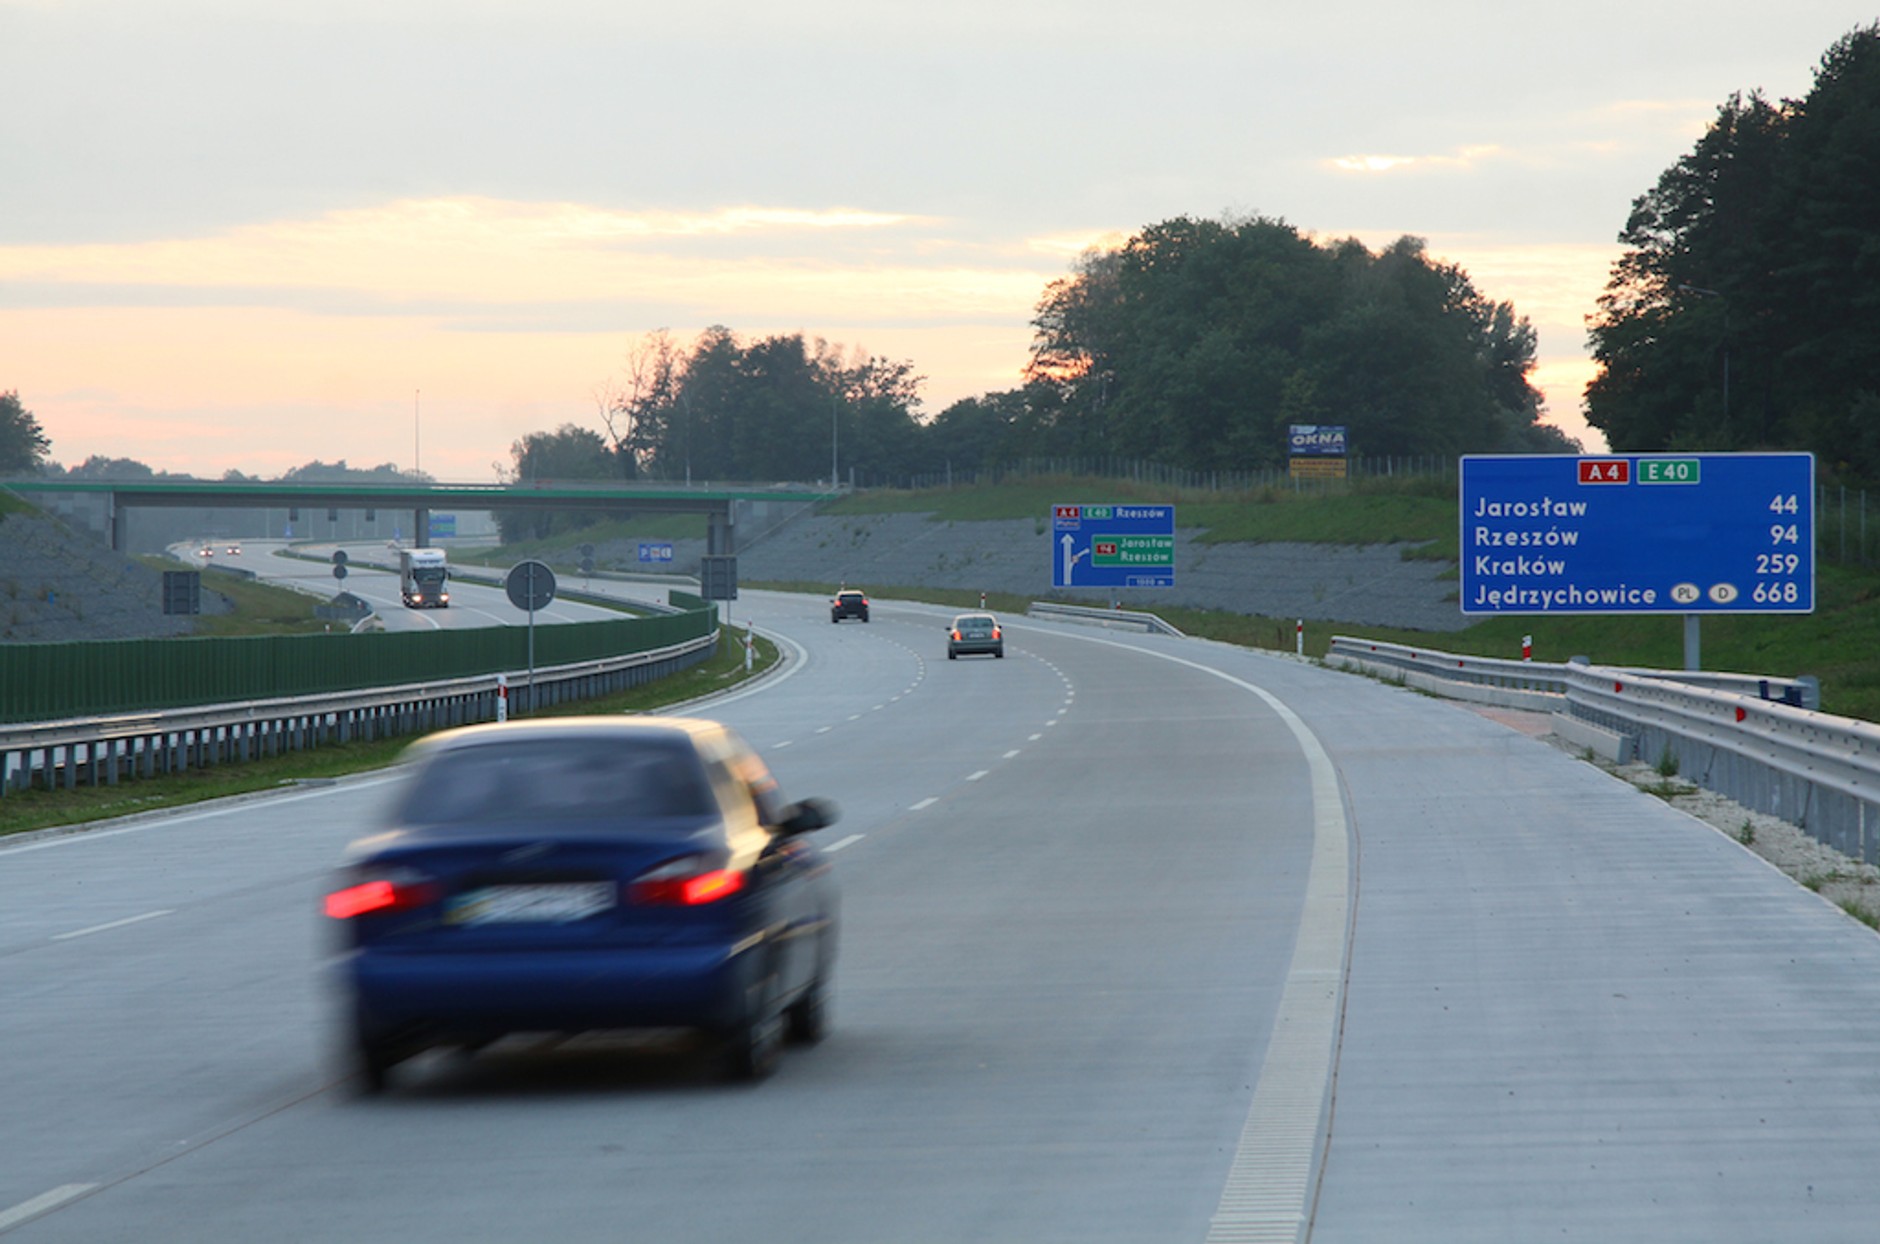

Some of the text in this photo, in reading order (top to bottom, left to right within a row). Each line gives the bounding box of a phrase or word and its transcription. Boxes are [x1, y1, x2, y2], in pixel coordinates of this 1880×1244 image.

[1292, 433, 1345, 446] OKNA
[1664, 464, 1688, 480] 40
[1116, 506, 1165, 518] Rzeszów
[1475, 495, 1798, 517] Jarosław 44
[1120, 538, 1172, 548] Jarosław
[1475, 524, 1798, 546] Rzeszów 94
[1120, 551, 1169, 562] Rzeszów
[1475, 554, 1799, 576] Kraków 259
[1474, 582, 1798, 610] Jędrzychowice PL D 668
